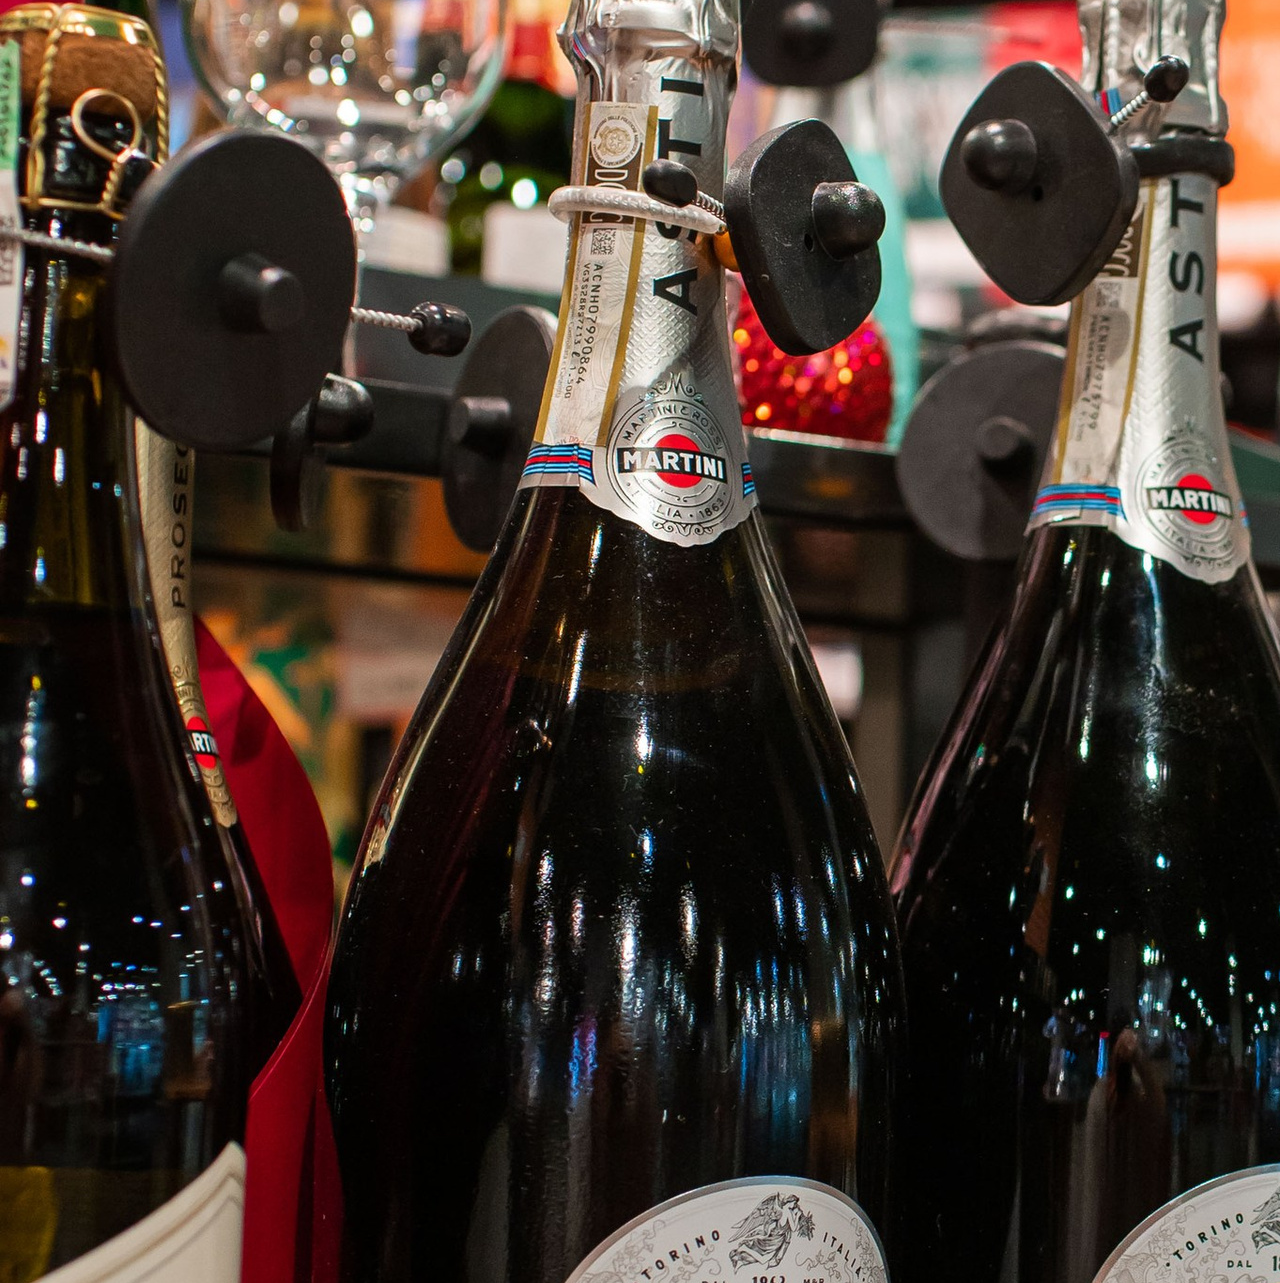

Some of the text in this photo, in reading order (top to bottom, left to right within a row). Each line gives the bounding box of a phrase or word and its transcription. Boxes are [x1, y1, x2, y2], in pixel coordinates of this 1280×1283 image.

[576, 263, 604, 385] ACNH07990864
[623, 450, 725, 480] MARTINI
[1150, 488, 1232, 516] MARTINI
[641, 1228, 721, 1281] TORINO
[821, 1230, 863, 1279] ITALIA
[1172, 1212, 1245, 1262] TORINO
[1227, 1259, 1253, 1269] DAL
